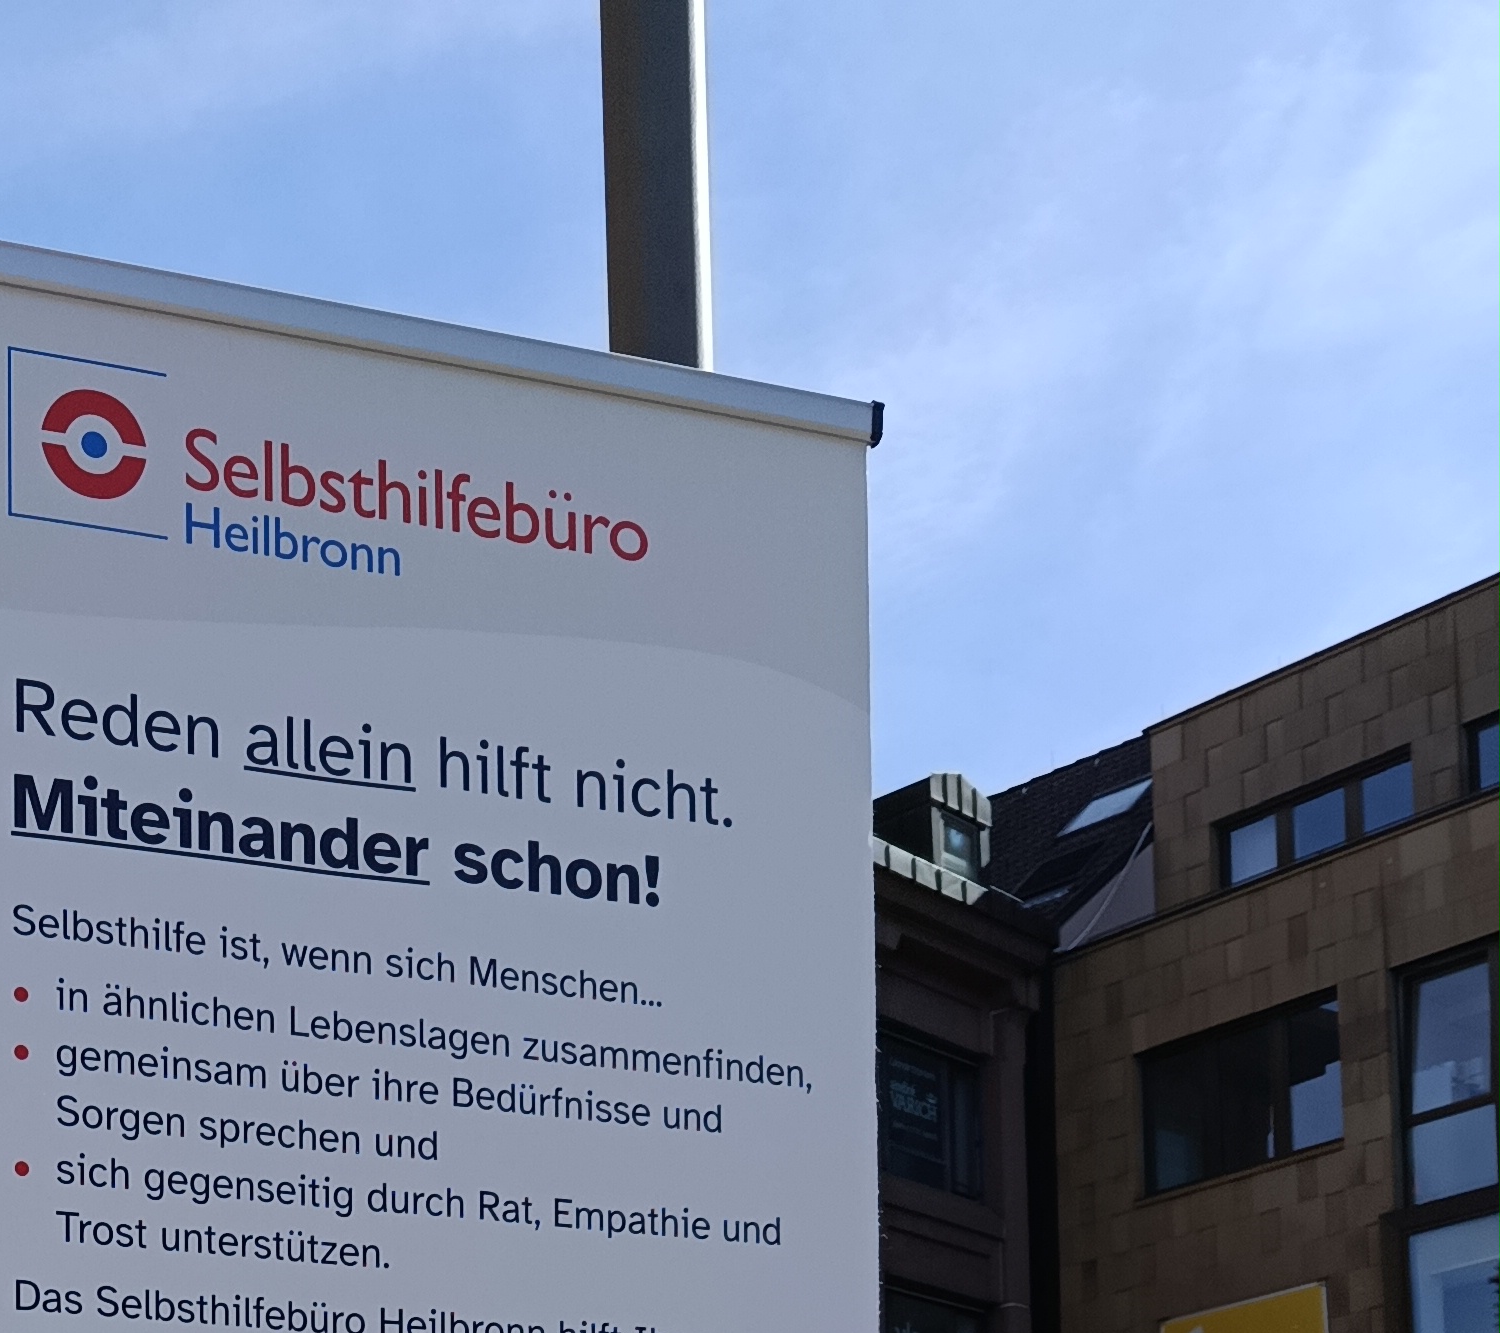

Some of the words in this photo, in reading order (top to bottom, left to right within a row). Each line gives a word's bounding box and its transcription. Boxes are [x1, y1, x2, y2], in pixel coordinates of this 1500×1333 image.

[186, 428, 648, 561] Selbsthilfebüro
[186, 502, 400, 576] Heilbronn
[16, 678, 218, 758] Reden
[244, 716, 416, 792] allein
[440, 736, 551, 803] hilft
[577, 759, 732, 827] nicht.
[11, 774, 430, 886] Miteinander
[454, 840, 659, 907] schon!
[13, 904, 206, 955] Selbsthilfe
[220, 926, 269, 969] ist,
[281, 943, 371, 975] wenn
[386, 947, 454, 983] sich
[56, 978, 87, 1012] in
[103, 983, 274, 1033] ähnlichen
[291, 1006, 509, 1059] Lebenslagen
[523, 1038, 811, 1094] zusammenfinden,
[57, 1045, 266, 1089] gemeinsam
[282, 1060, 359, 1098] über
[372, 1069, 438, 1104] ihre
[453, 1077, 650, 1126] Bedürfnisse
[664, 1105, 721, 1133] und
[57, 1095, 184, 1140] Sorgen
[200, 1117, 360, 1154] sprechen
[376, 1131, 437, 1160] und
[56, 1211, 147, 1249] Trost
[162, 1226, 389, 1268] unterstützen.
[57, 1153, 129, 1189] sich
[145, 1169, 352, 1217] gegenseitig
[368, 1183, 464, 1218] durch
[480, 1191, 540, 1230] Rat,
[555, 1198, 710, 1239] Empathie
[724, 1217, 780, 1245] und
[16, 1279, 82, 1314] Das
